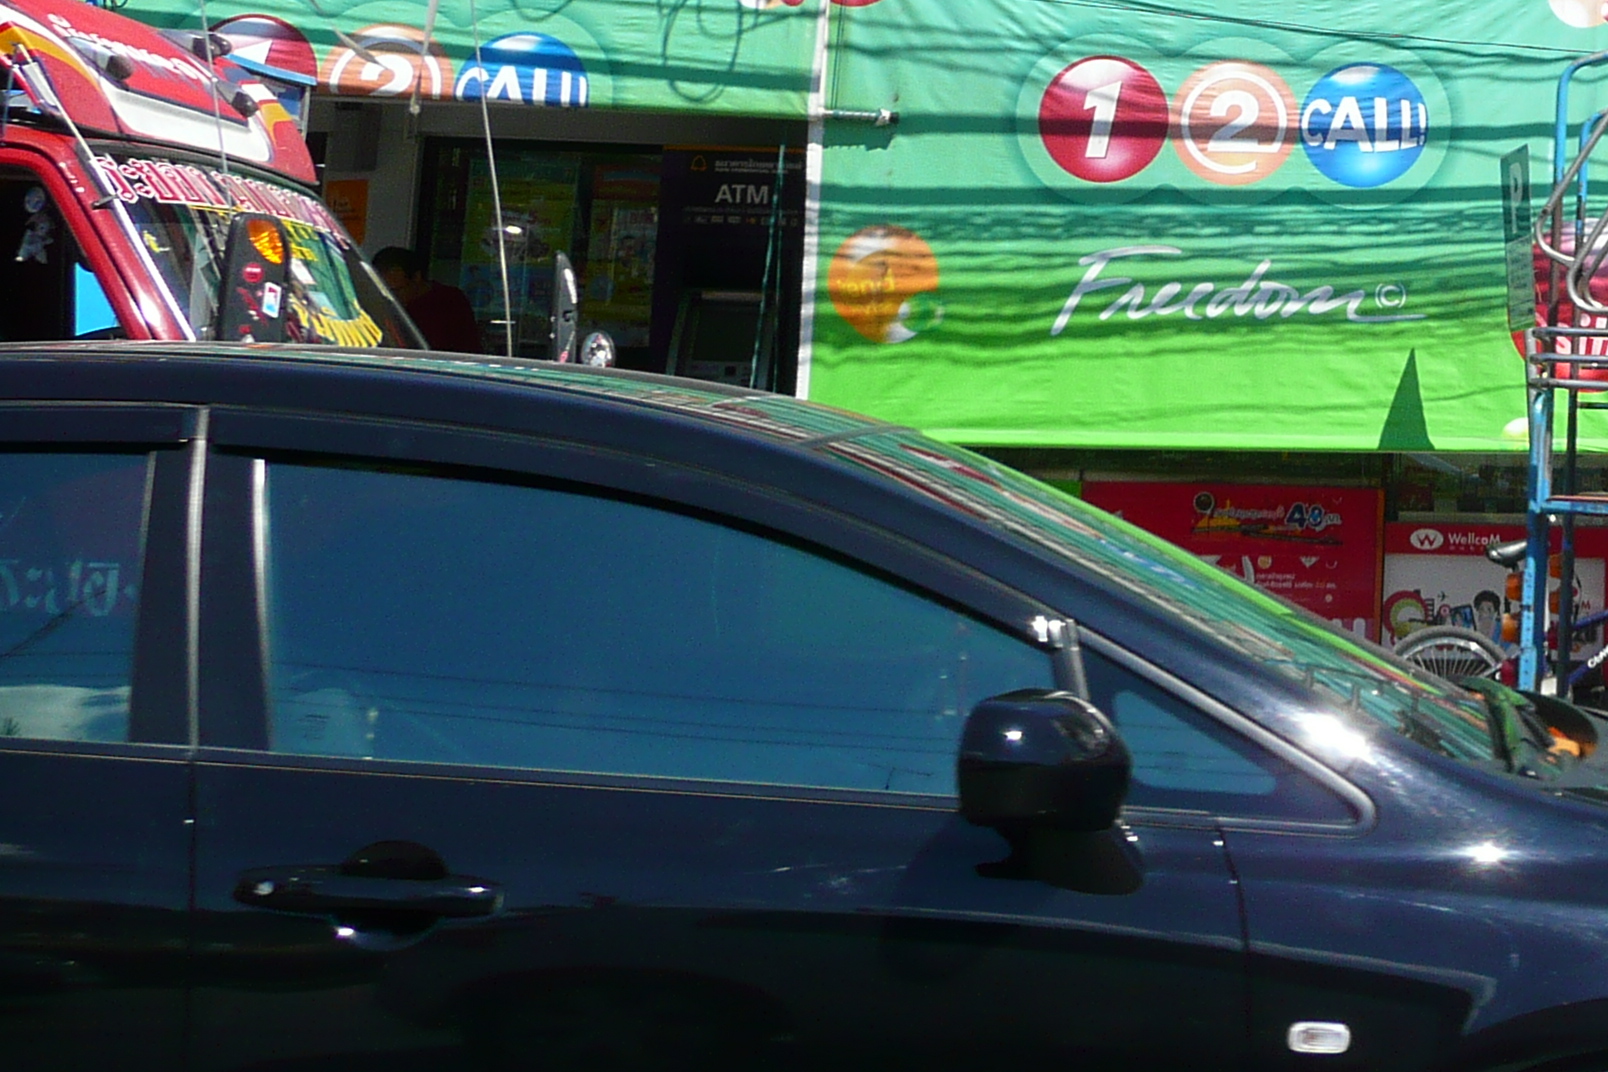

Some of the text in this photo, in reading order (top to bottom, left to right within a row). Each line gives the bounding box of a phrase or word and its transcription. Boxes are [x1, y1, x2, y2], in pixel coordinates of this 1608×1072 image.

[1082, 80, 1122, 159] 1
[1301, 95, 1427, 154] CALL!
[714, 183, 769, 205] ATM
[1050, 244, 1428, 336] Freedom
